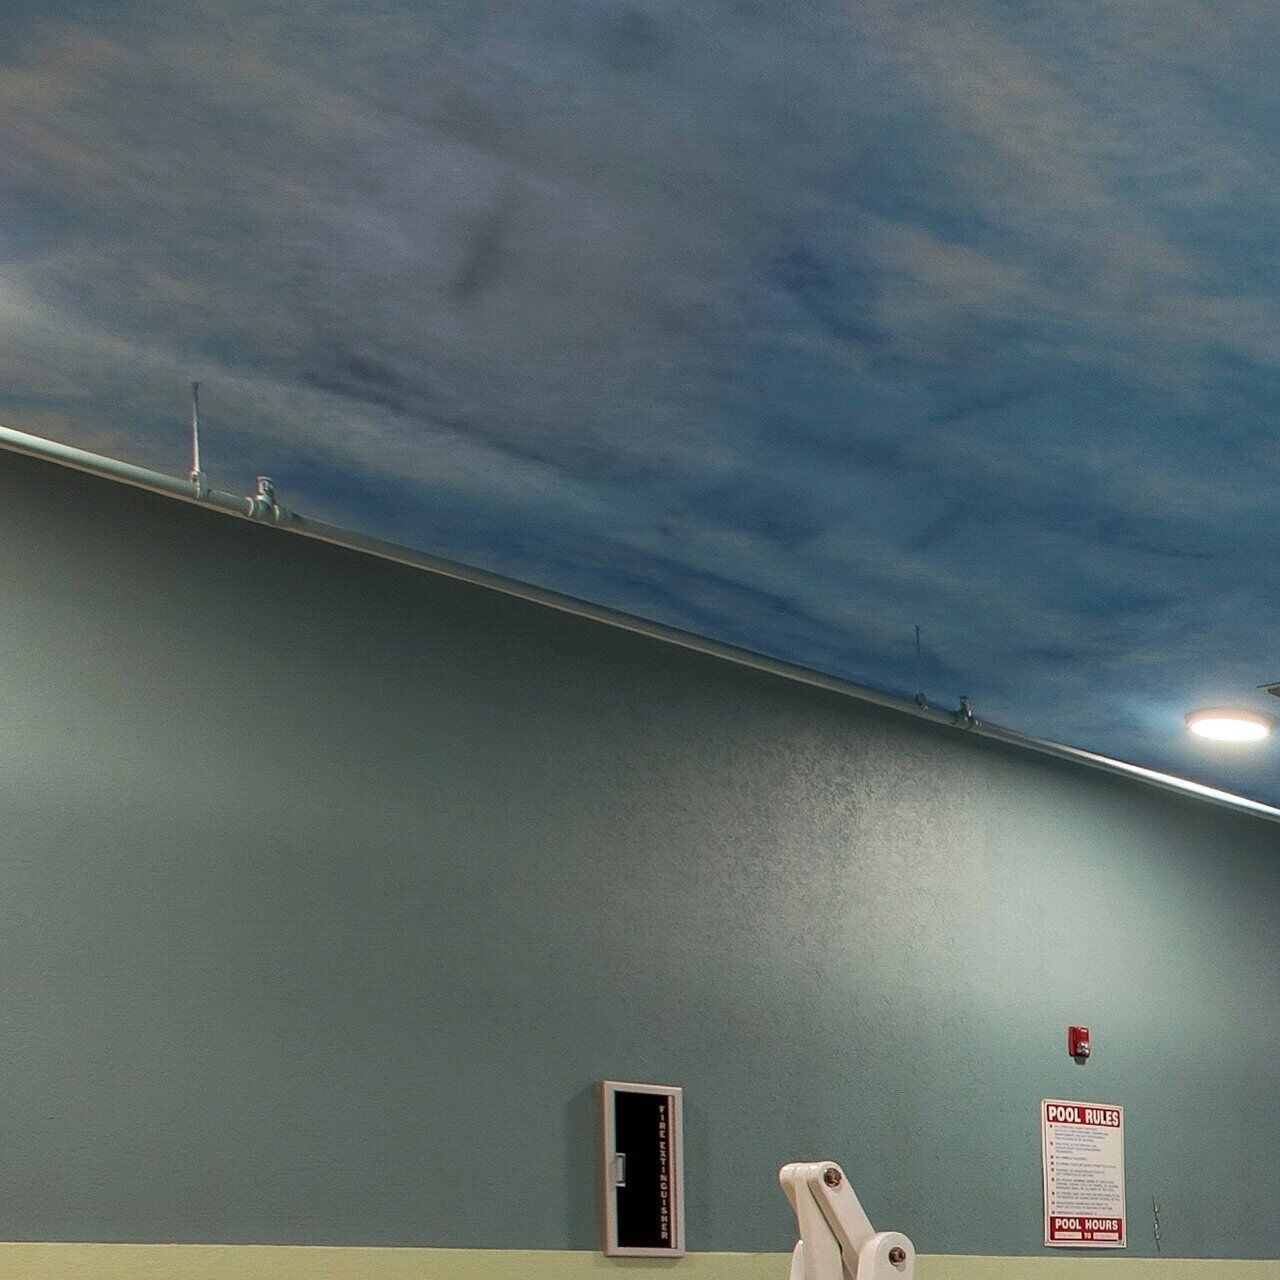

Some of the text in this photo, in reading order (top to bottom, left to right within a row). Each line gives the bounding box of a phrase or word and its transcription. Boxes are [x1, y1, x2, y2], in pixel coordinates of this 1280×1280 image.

[1048, 1105, 1119, 1127] POOL RULES
[659, 1141, 669, 1240] EXTINGUISHER
[1055, 1218, 1118, 1231] POOL HOURS
